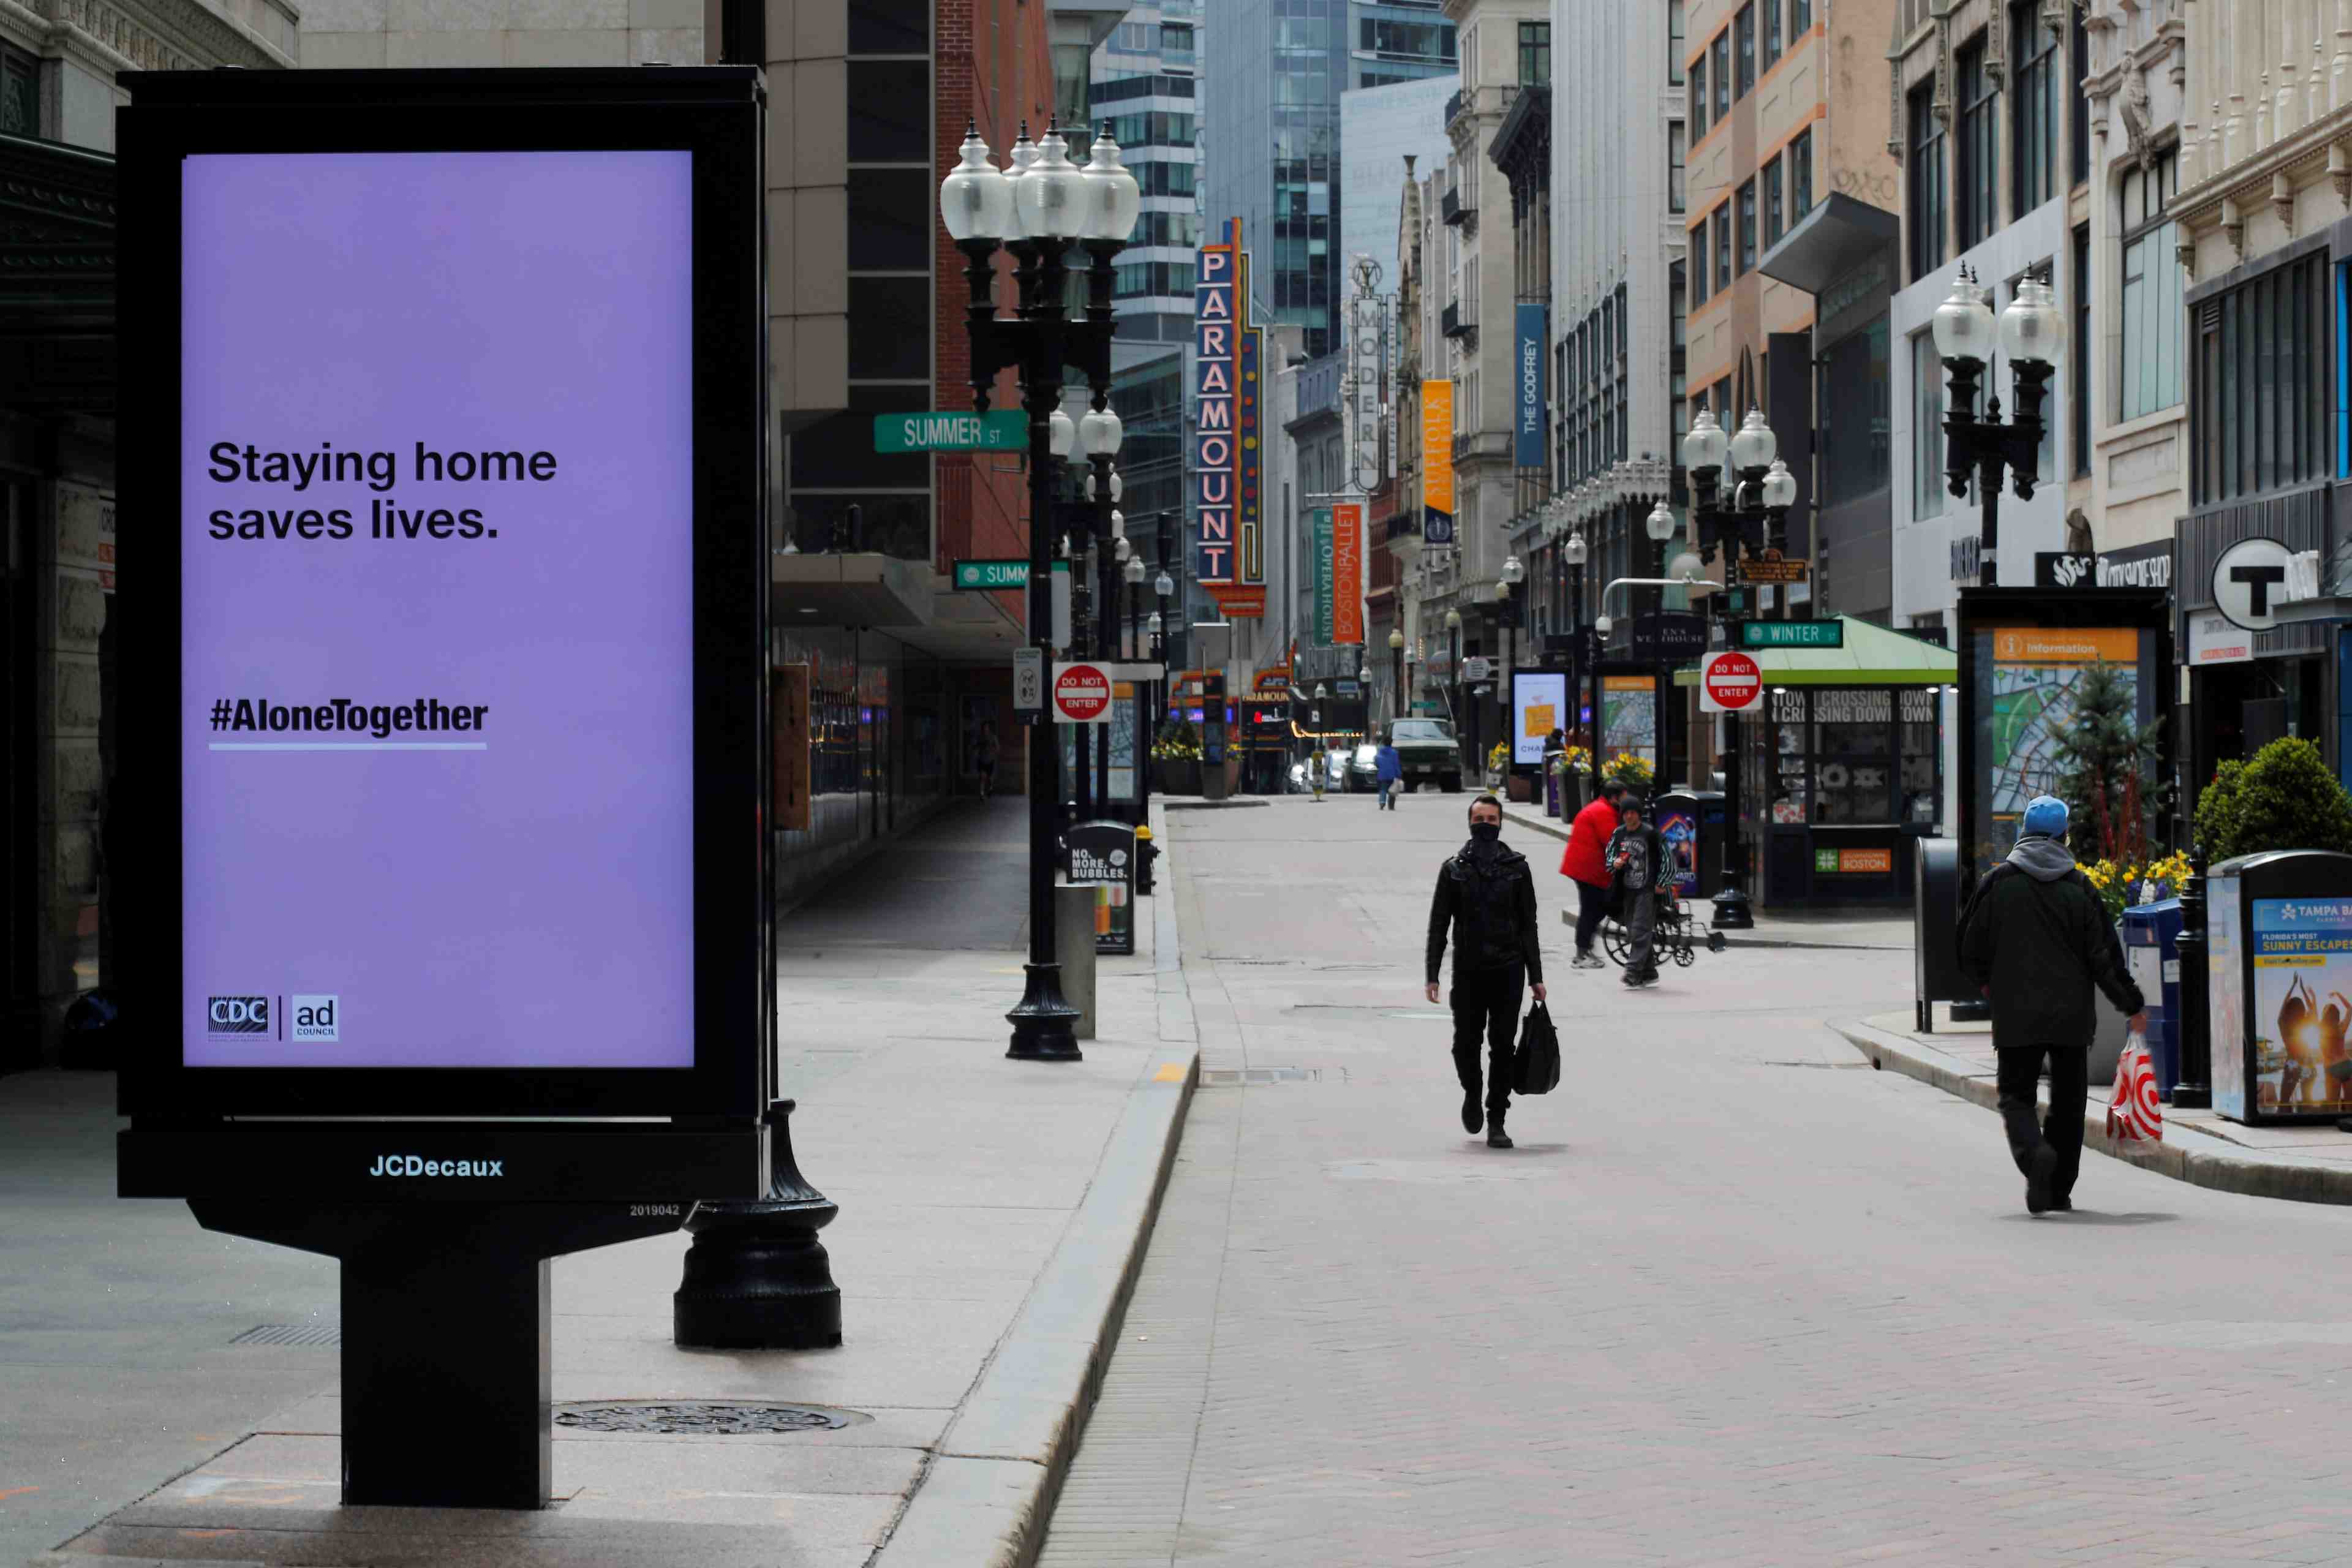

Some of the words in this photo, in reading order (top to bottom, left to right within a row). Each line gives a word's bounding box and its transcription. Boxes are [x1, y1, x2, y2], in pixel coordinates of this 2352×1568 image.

[1524, 337, 1536, 403] GODFREY
[1359, 309, 1378, 470] MODERN
[1201, 252, 1227, 577] PARAMOUNT
[1525, 405, 1536, 434] THE
[904, 418, 981, 447] SUMMER
[989, 430, 1000, 443] ST
[1425, 396, 1440, 496] SUFFOLK
[208, 442, 396, 492] Staying
[415, 442, 557, 481] home
[208, 506, 353, 540] saves
[371, 499, 498, 539] lives.
[987, 565, 1030, 583] SUMM
[2230, 566, 2285, 616] T
[1322, 594, 1333, 638] HOUSE
[1770, 625, 1819, 641] WINTER
[2027, 643, 2097, 653] Information
[1733, 664, 1751, 673] NOT
[1061, 677, 1076, 686] DO
[1082, 677, 1102, 685] NOT
[1718, 688, 1748, 696] ENTER
[1821, 690, 1891, 705] CROSSING
[1066, 699, 1098, 708] ENTER
[210, 698, 488, 739] #AloneTogether
[1072, 848, 1092, 859] NO.
[1072, 859, 1107, 869] MORE.
[1843, 859, 1887, 869] BOSTON
[1072, 869, 1128, 878] BUBBLES.
[2297, 905, 2339, 916] TAMPA
[2341, 905, 2352, 916] BA
[2263, 940, 2301, 951] SUNNY
[210, 1000, 267, 1023] CDC
[296, 1000, 334, 1027] ad
[370, 1155, 503, 1178] JCDecaux
[630, 1203, 680, 1218] 2019042
